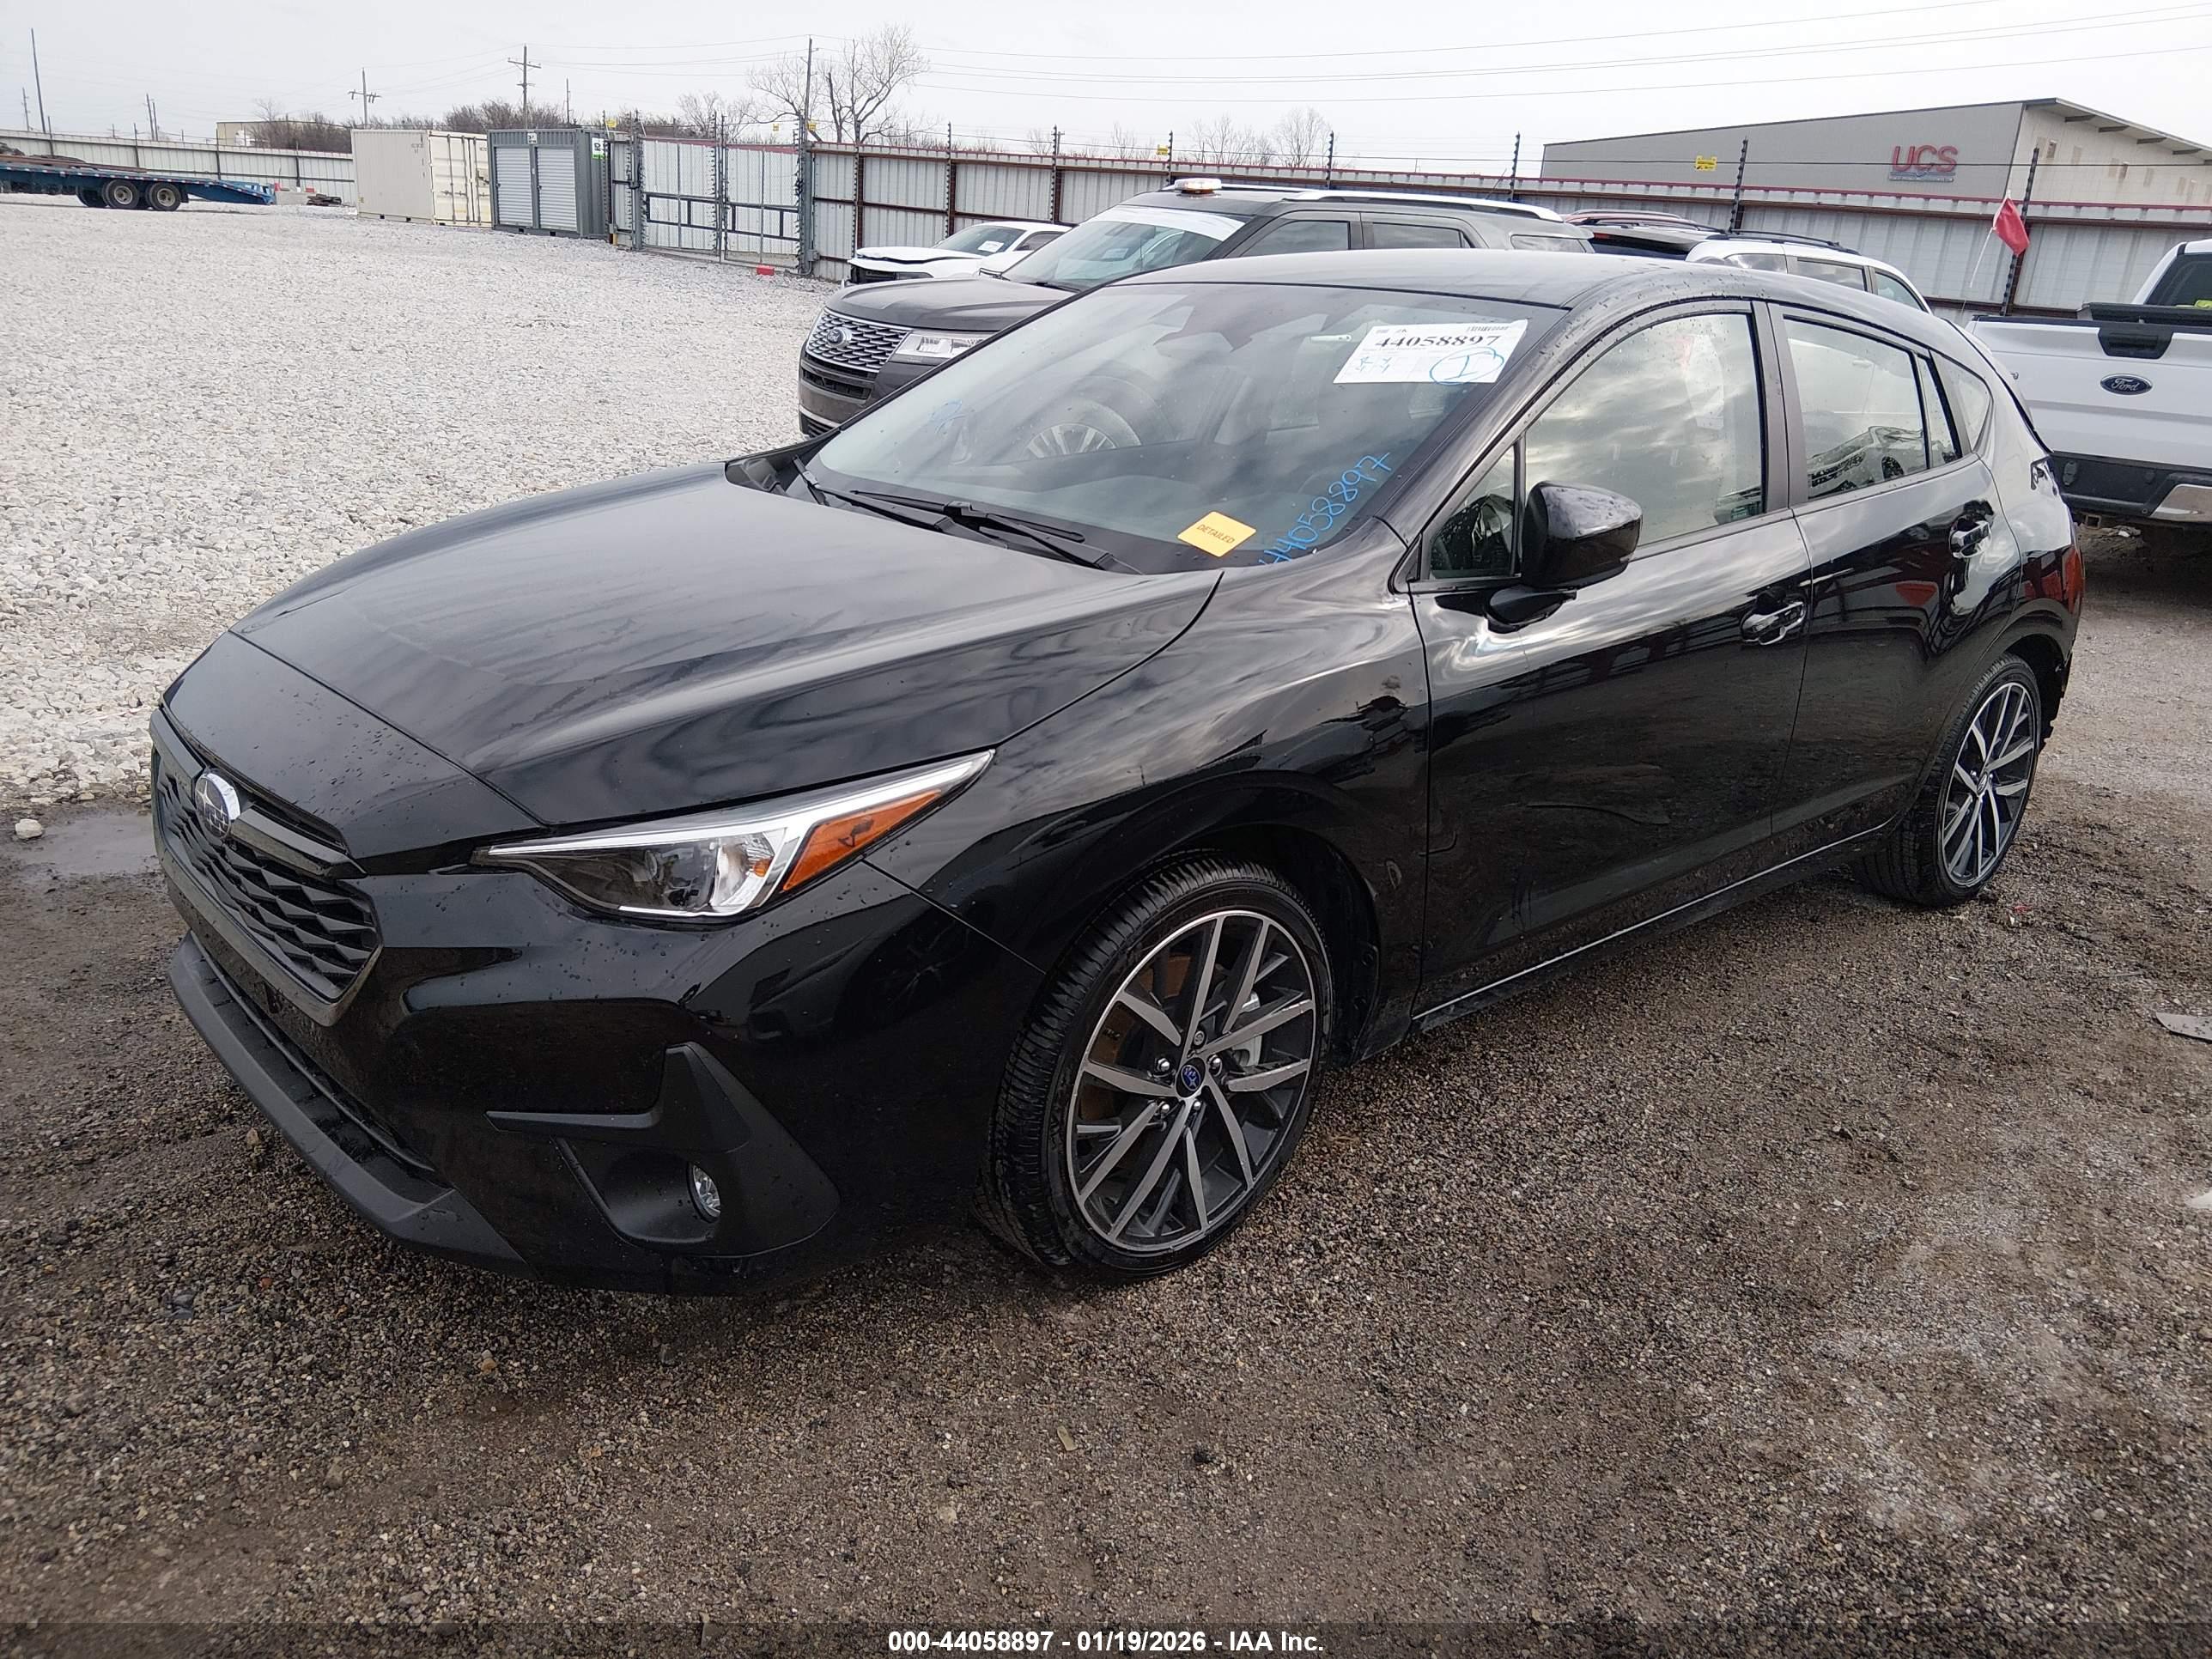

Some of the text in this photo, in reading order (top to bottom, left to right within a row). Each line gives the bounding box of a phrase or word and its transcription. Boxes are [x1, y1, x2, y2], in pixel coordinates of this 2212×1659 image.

[1892, 144, 1959, 173] UCS
[1375, 334, 1502, 348] 44058897
[2112, 378, 2140, 392] Ford
[1196, 524, 1236, 544] DETAILED
